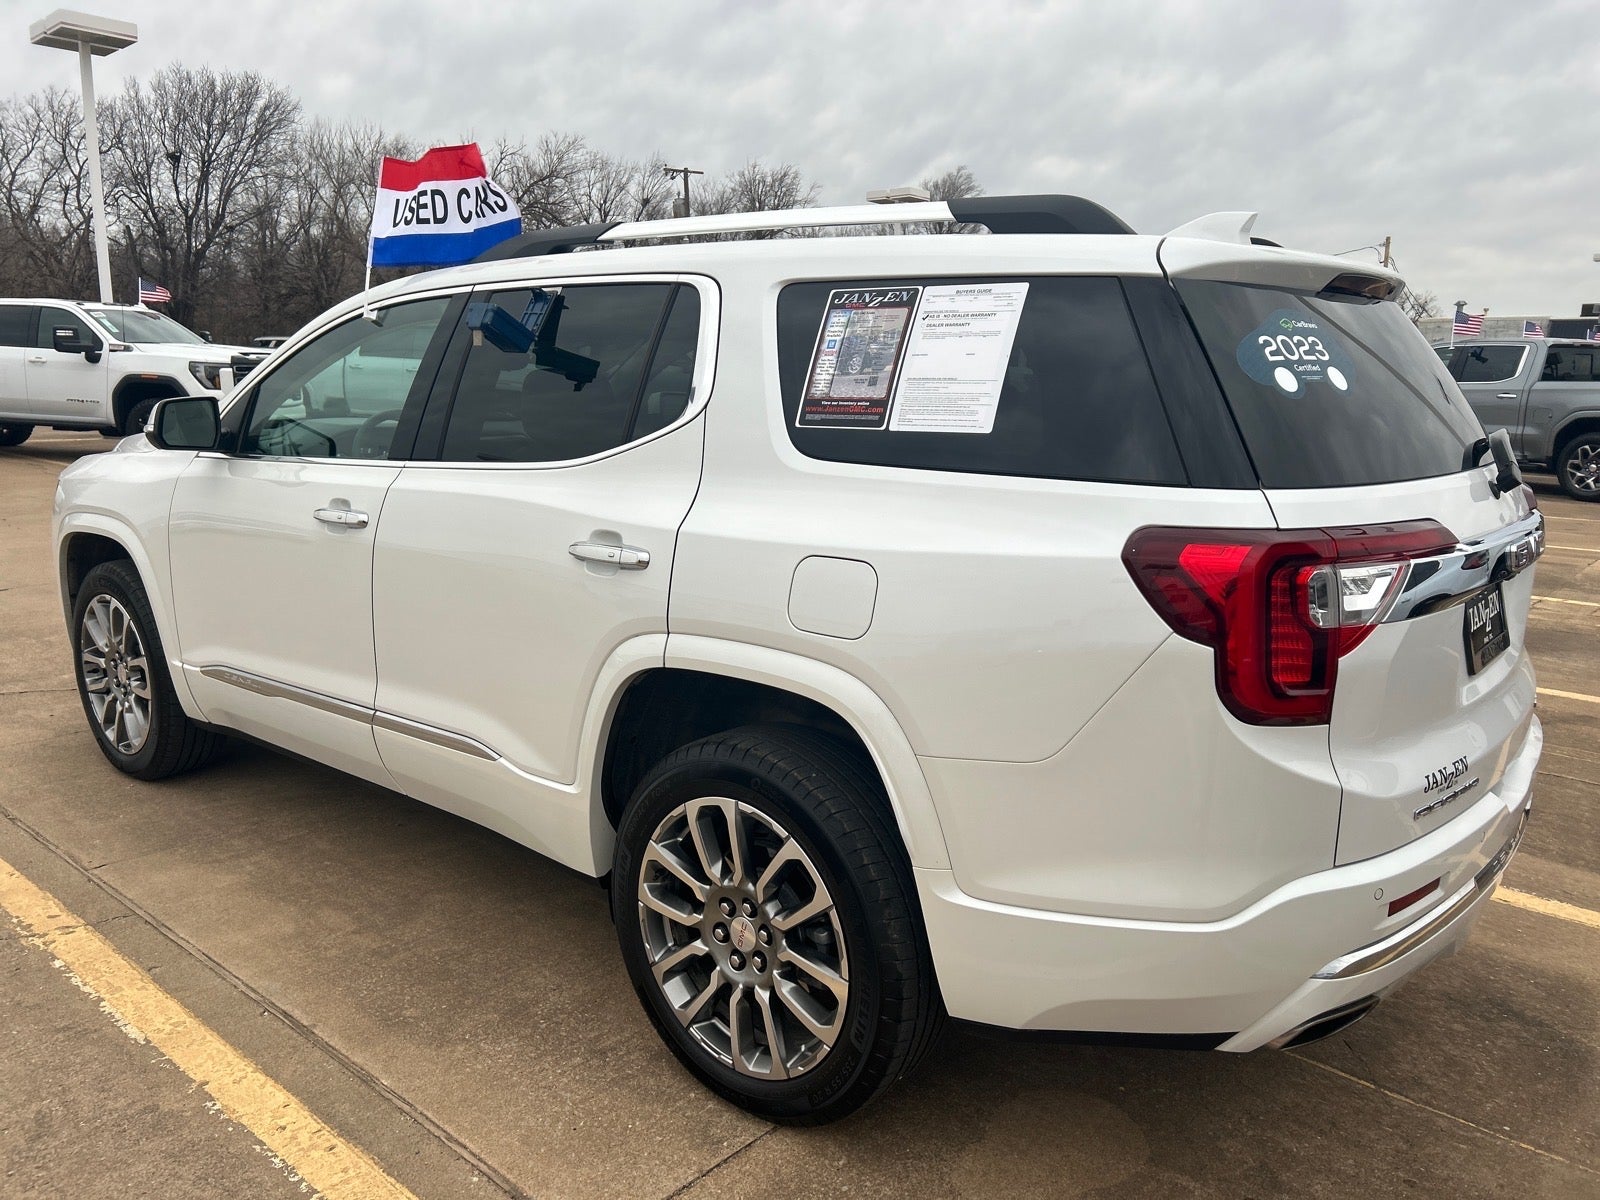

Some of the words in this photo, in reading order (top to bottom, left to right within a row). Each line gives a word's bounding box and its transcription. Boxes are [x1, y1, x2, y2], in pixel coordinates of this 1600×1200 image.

[392, 188, 449, 228] USED
[456, 179, 508, 224] CARS
[834, 291, 915, 308] JANZEN
[1258, 334, 1330, 361] 2023
[805, 405, 884, 414] www.JanzenGMC.com
[1468, 590, 1500, 633] JANZEN
[1423, 756, 1469, 794] JANZEN
[737, 921, 748, 948] GMC
